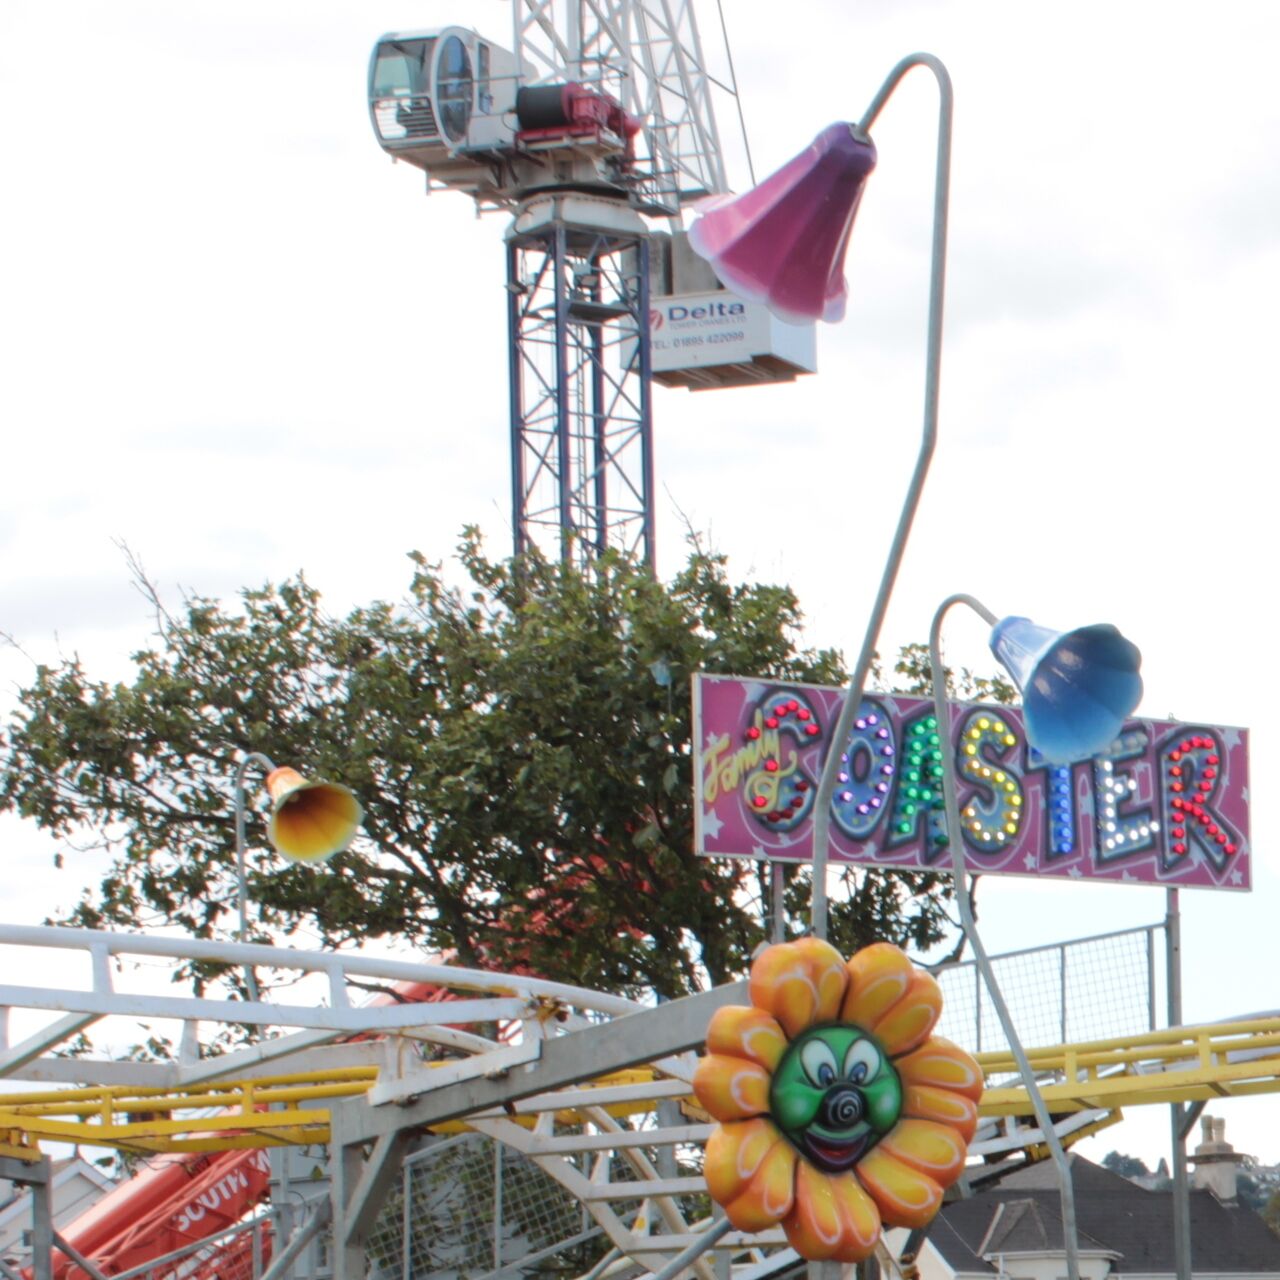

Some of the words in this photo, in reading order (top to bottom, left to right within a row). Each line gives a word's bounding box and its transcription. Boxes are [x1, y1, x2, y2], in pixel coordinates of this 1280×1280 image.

[668, 303, 745, 321] Delta
[743, 687, 1237, 872] COASTER
[171, 1168, 249, 1232] SOUTH
